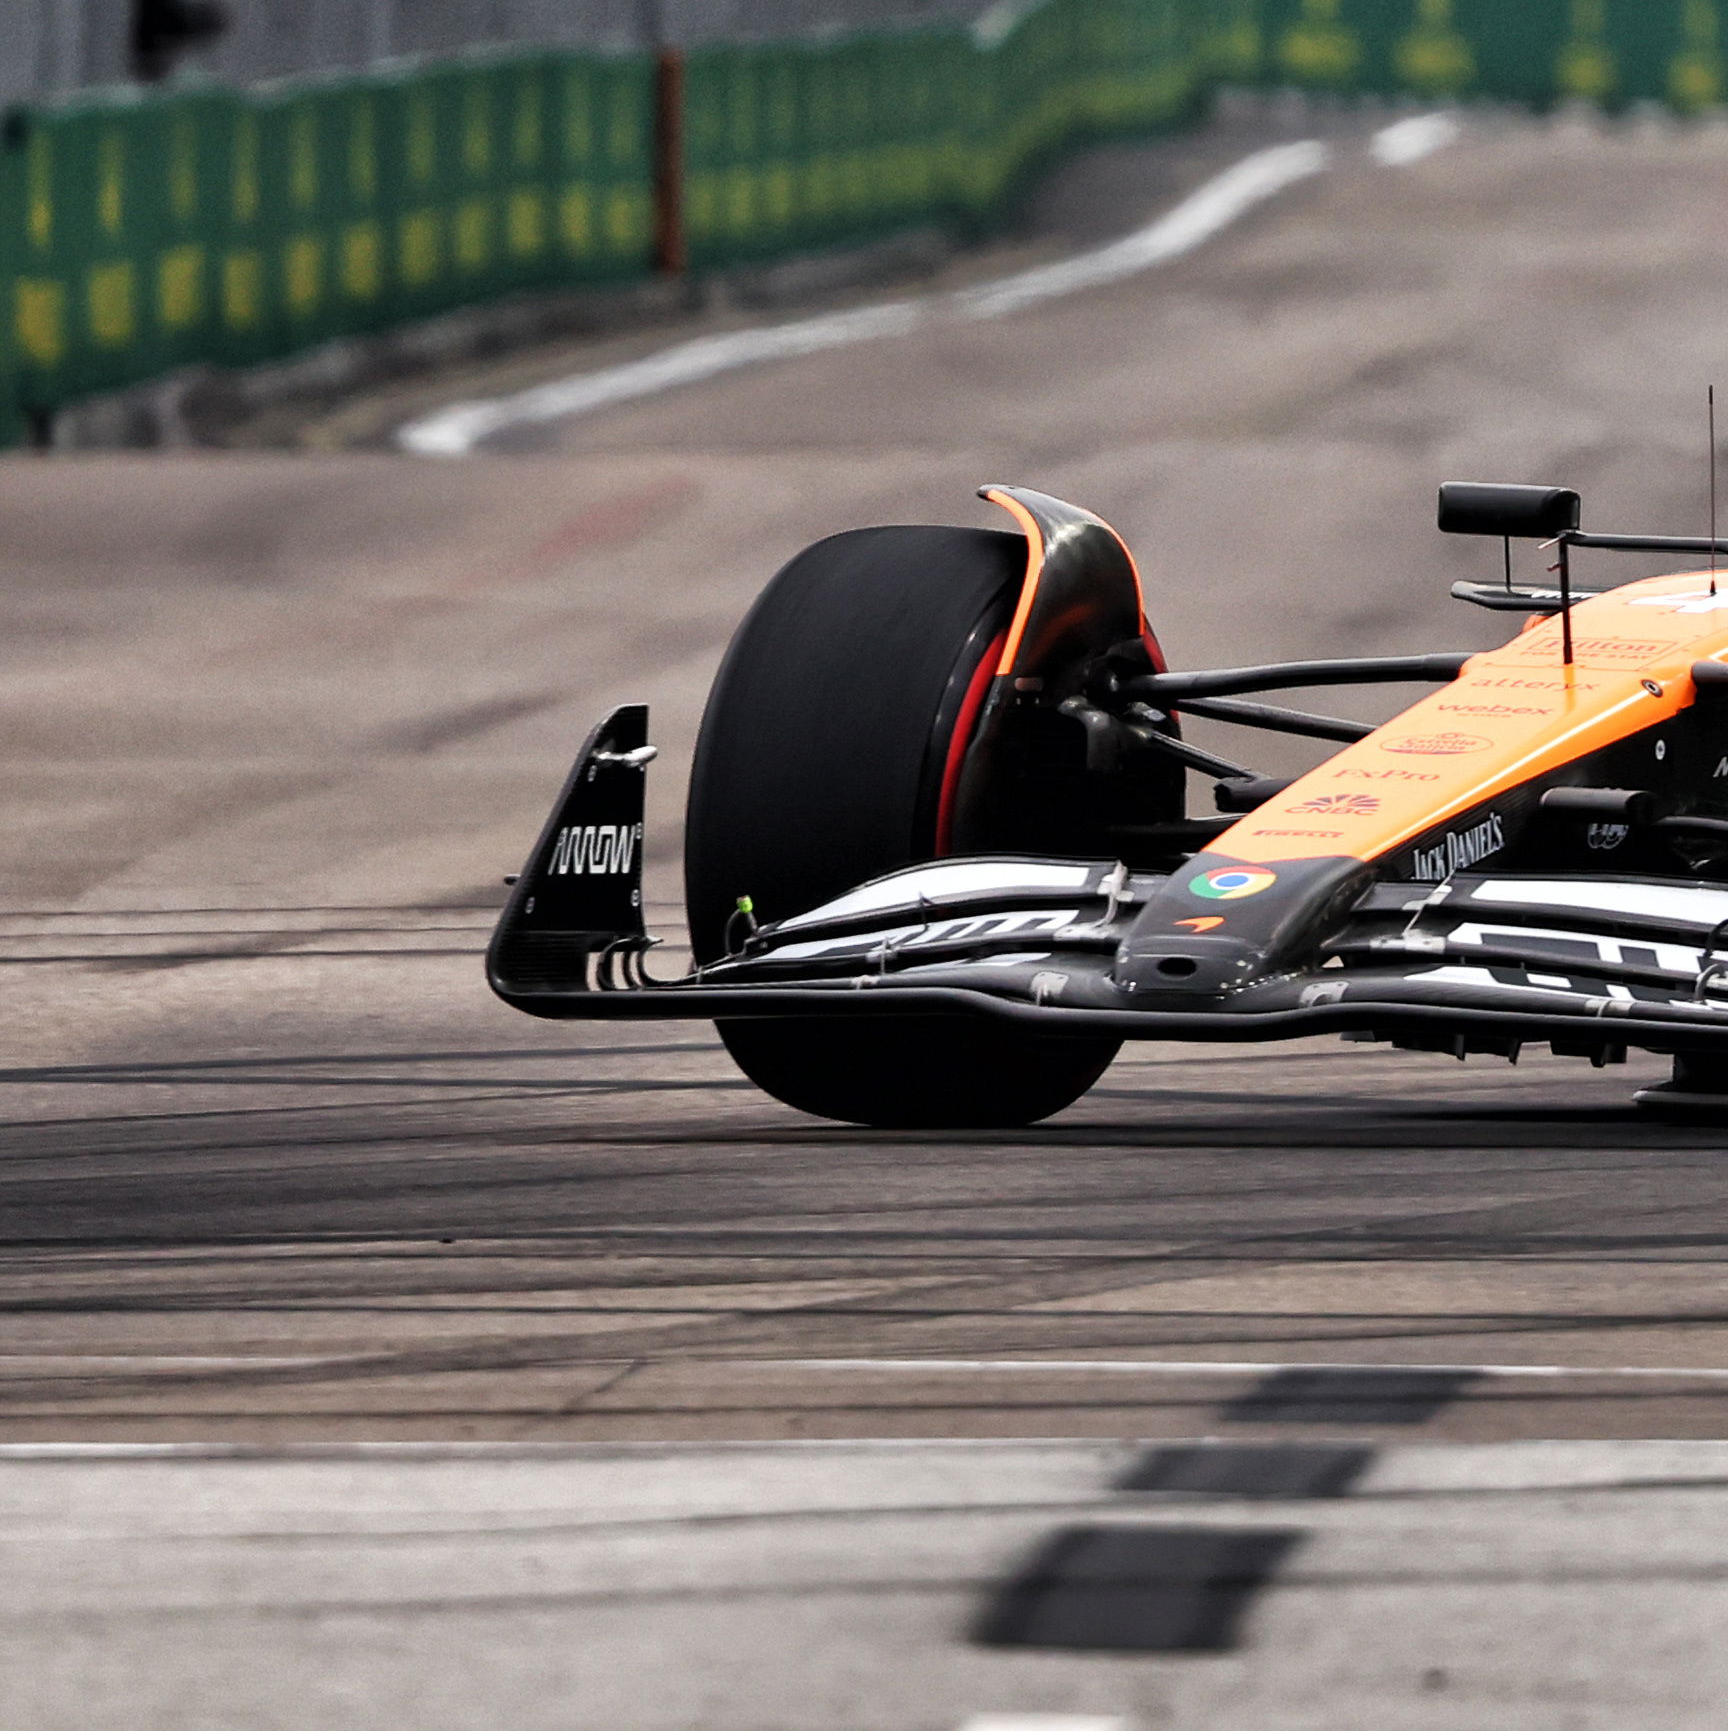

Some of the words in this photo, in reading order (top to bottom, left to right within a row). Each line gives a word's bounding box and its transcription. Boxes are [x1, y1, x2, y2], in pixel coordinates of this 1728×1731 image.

[1471, 678, 1600, 691] alteryx
[1438, 704, 1555, 715] webex
[1333, 769, 1441, 781] FxPro
[1284, 806, 1379, 816] CNBC
[1410, 847, 1447, 881] JACK
[1446, 811, 1505, 871] DANIEL'S
